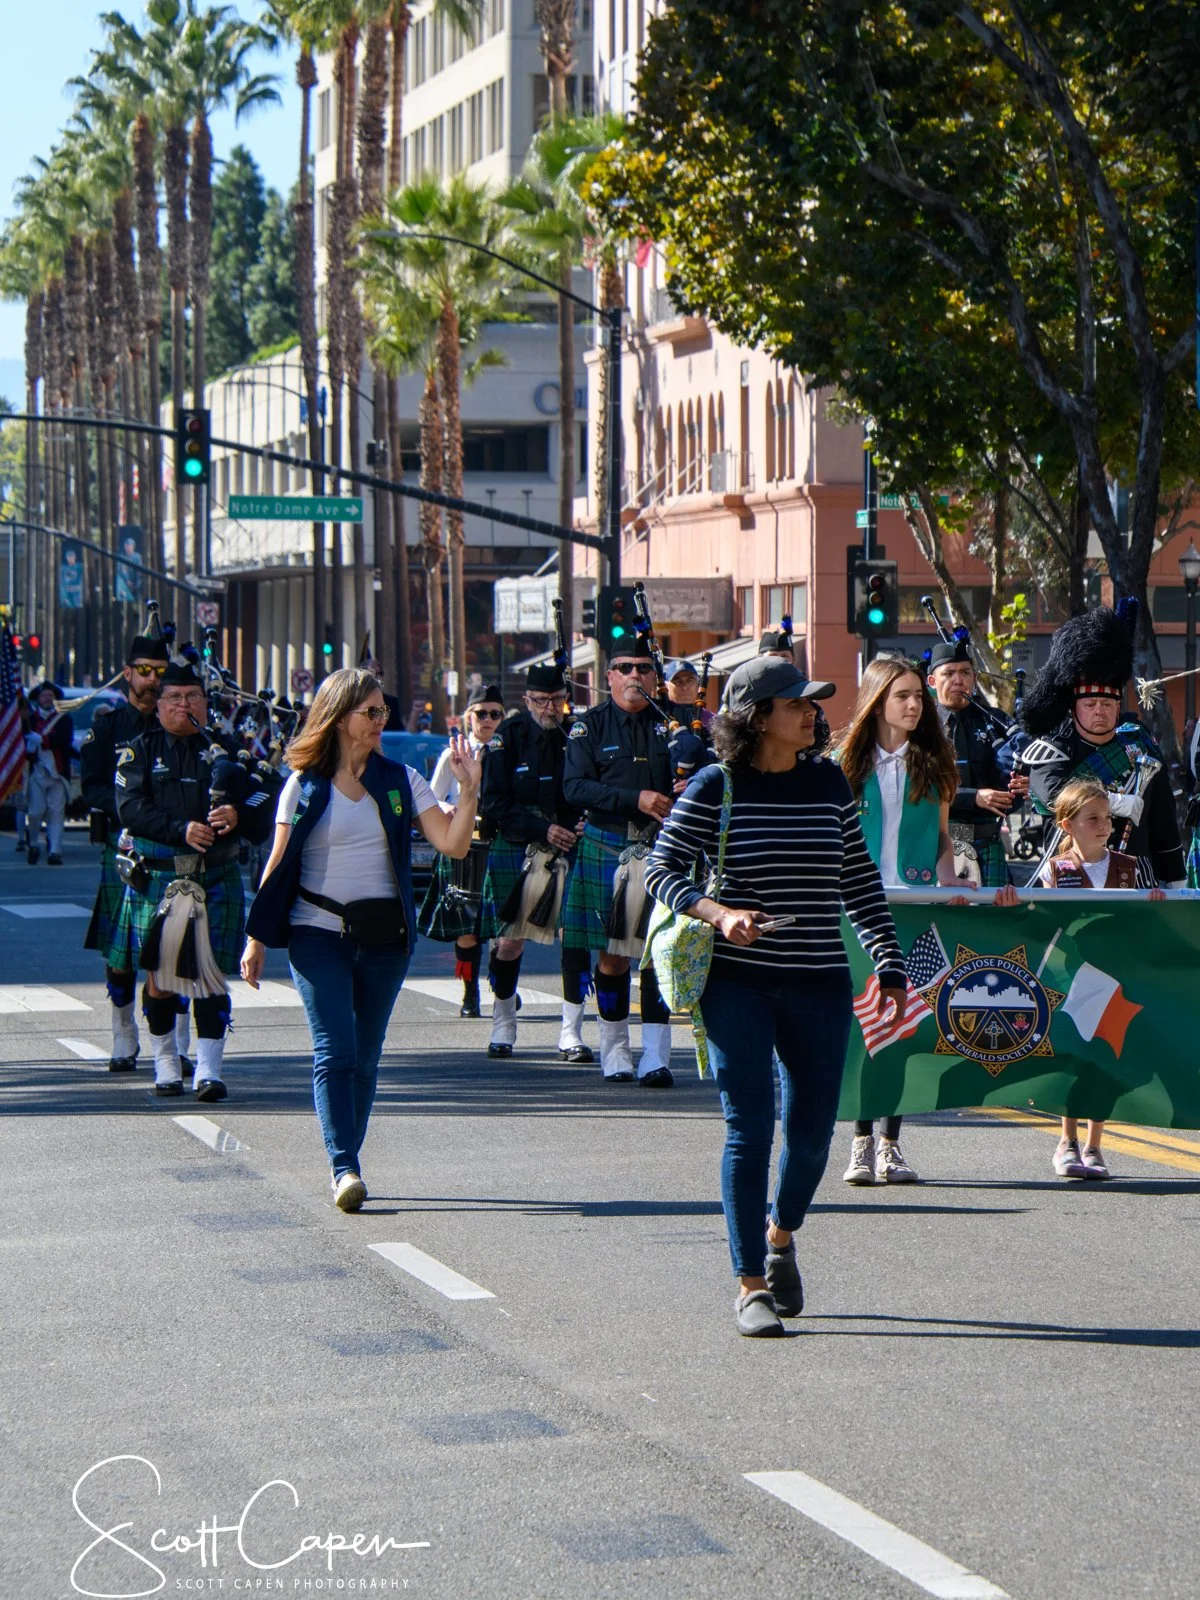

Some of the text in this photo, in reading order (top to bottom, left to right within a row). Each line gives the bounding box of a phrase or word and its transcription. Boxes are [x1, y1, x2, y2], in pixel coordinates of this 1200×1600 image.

[231, 501, 340, 516] Notre Dame Ave
[953, 958, 1030, 982] SAN JOSE POLICE
[955, 1042, 1033, 1062] EMERALD SOCIETY
